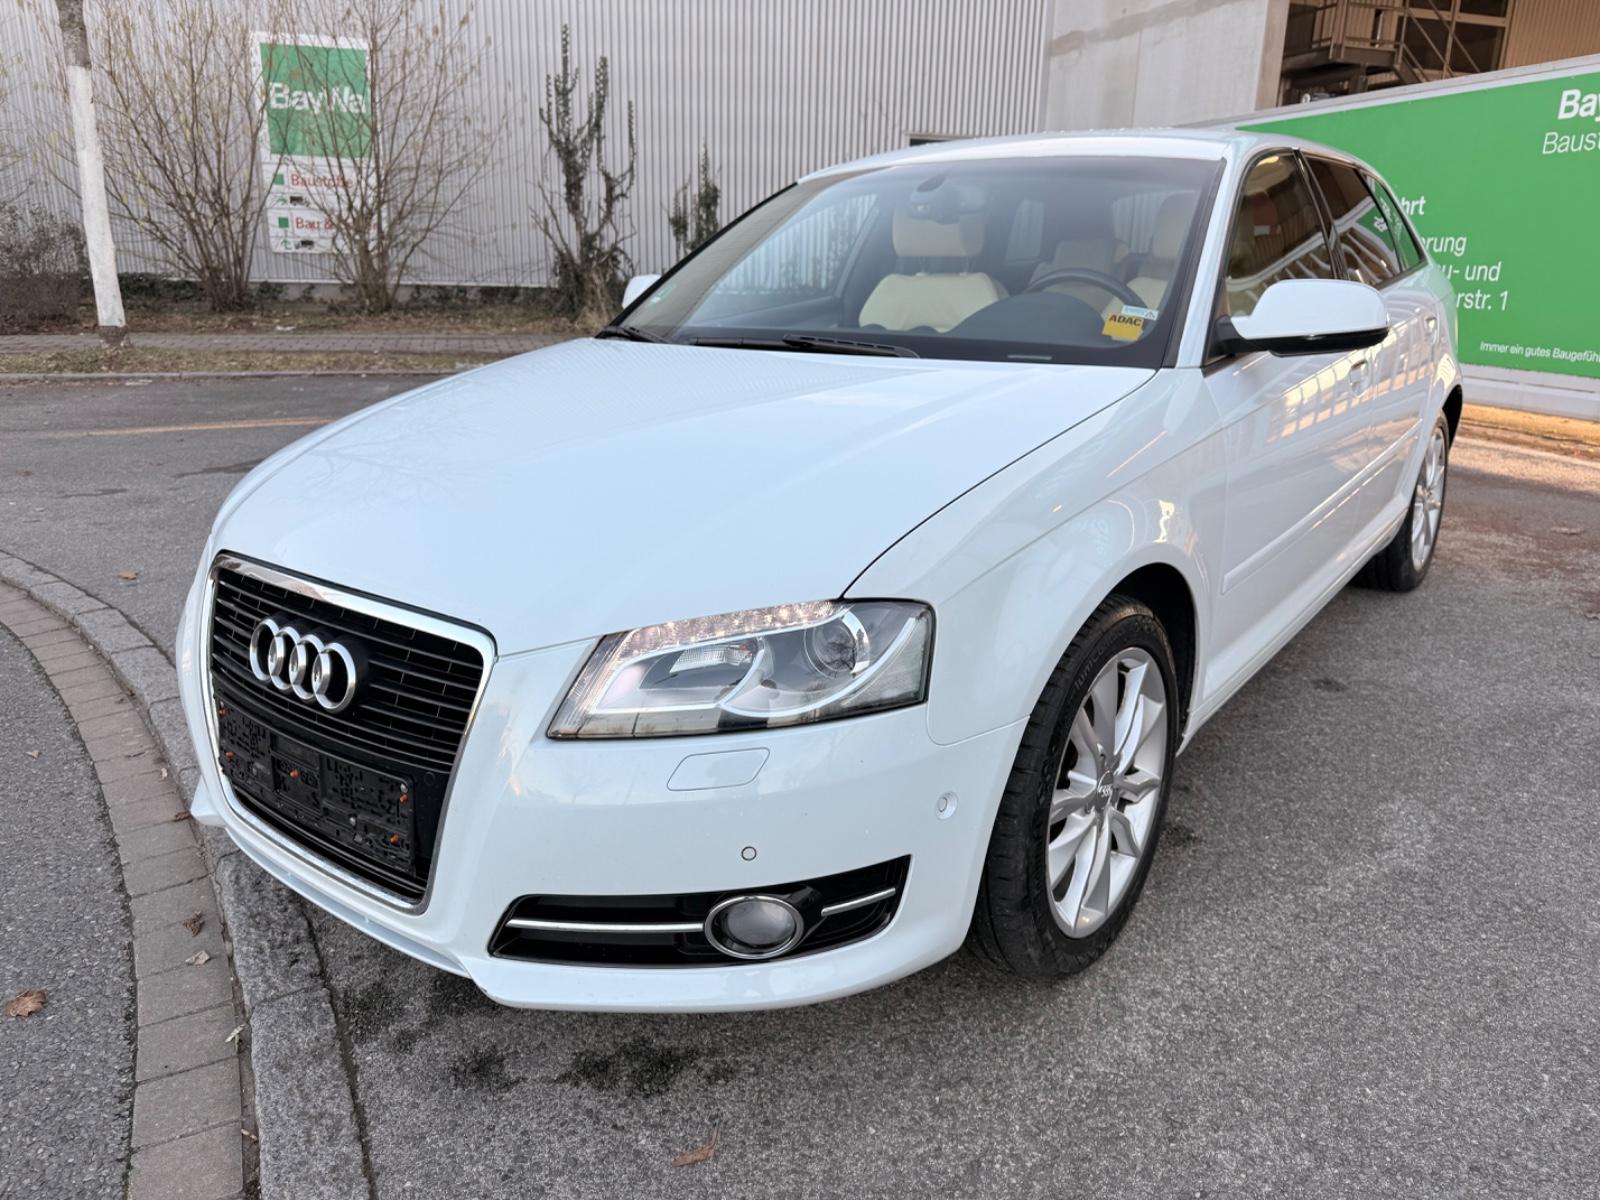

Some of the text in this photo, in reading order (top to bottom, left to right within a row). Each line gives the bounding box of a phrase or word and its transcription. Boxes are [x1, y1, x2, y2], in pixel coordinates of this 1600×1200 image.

[1464, 261, 1502, 282] und
[1456, 289, 1508, 311] rstr. 1
[1109, 314, 1142, 327] ADAC
[1480, 340, 1509, 353] Immer
[1510, 344, 1524, 355] ein
[1525, 347, 1551, 358] gutes
